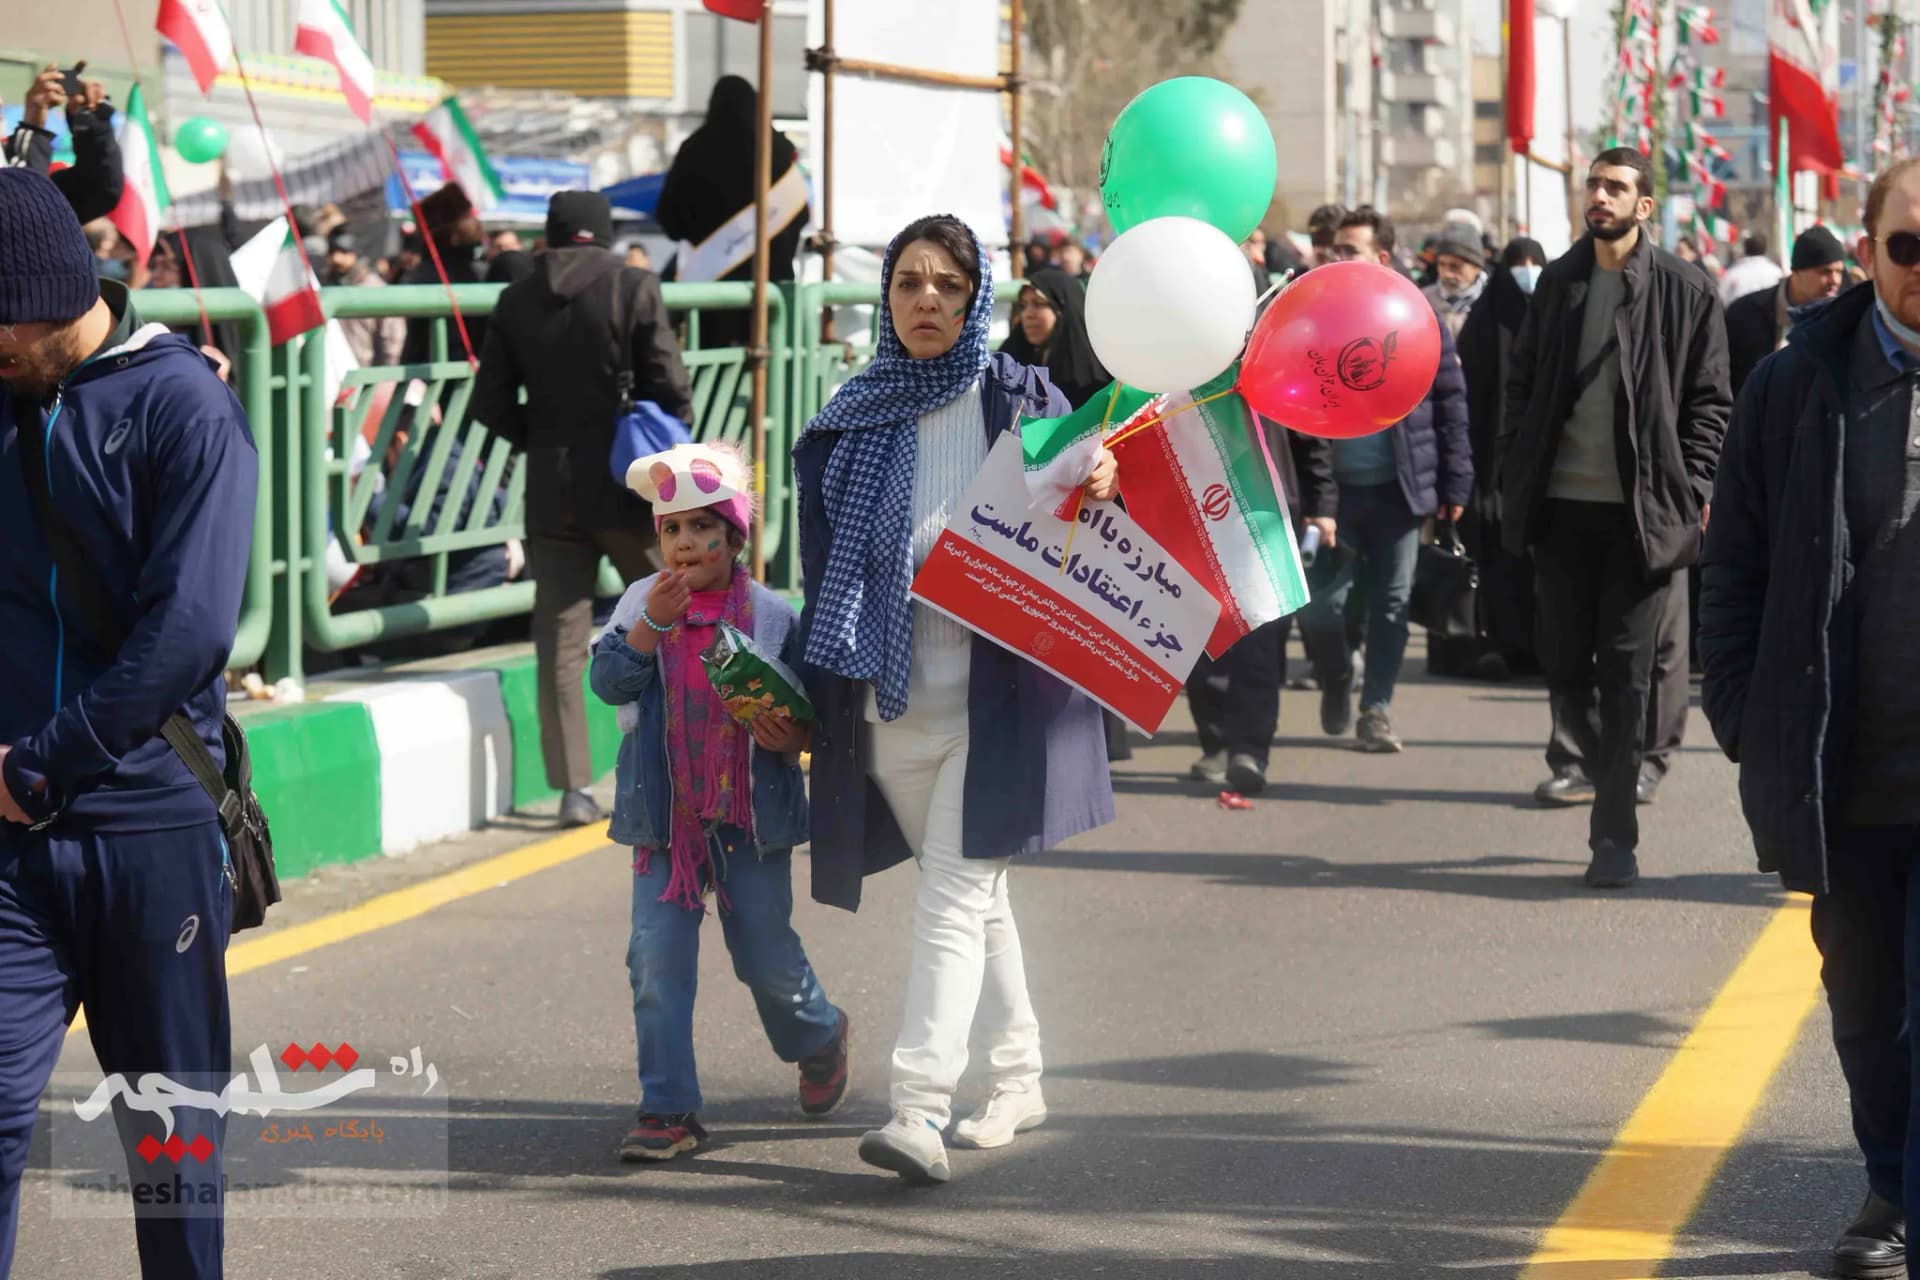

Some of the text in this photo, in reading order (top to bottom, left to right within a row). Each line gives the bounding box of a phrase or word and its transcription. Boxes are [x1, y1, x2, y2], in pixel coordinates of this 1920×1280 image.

[971, 504, 1039, 552] ماست
[1100, 516, 1117, 549] با
[968, 559, 988, 570] ایران
[1117, 538, 1181, 598] مبارزه
[982, 582, 1002, 593] ایران
[1041, 545, 1143, 620] اعتقادات
[998, 593, 1026, 606] اسلامی
[1074, 620, 1092, 631] است
[1088, 631, 1103, 640] این
[1137, 617, 1183, 658] جزء
